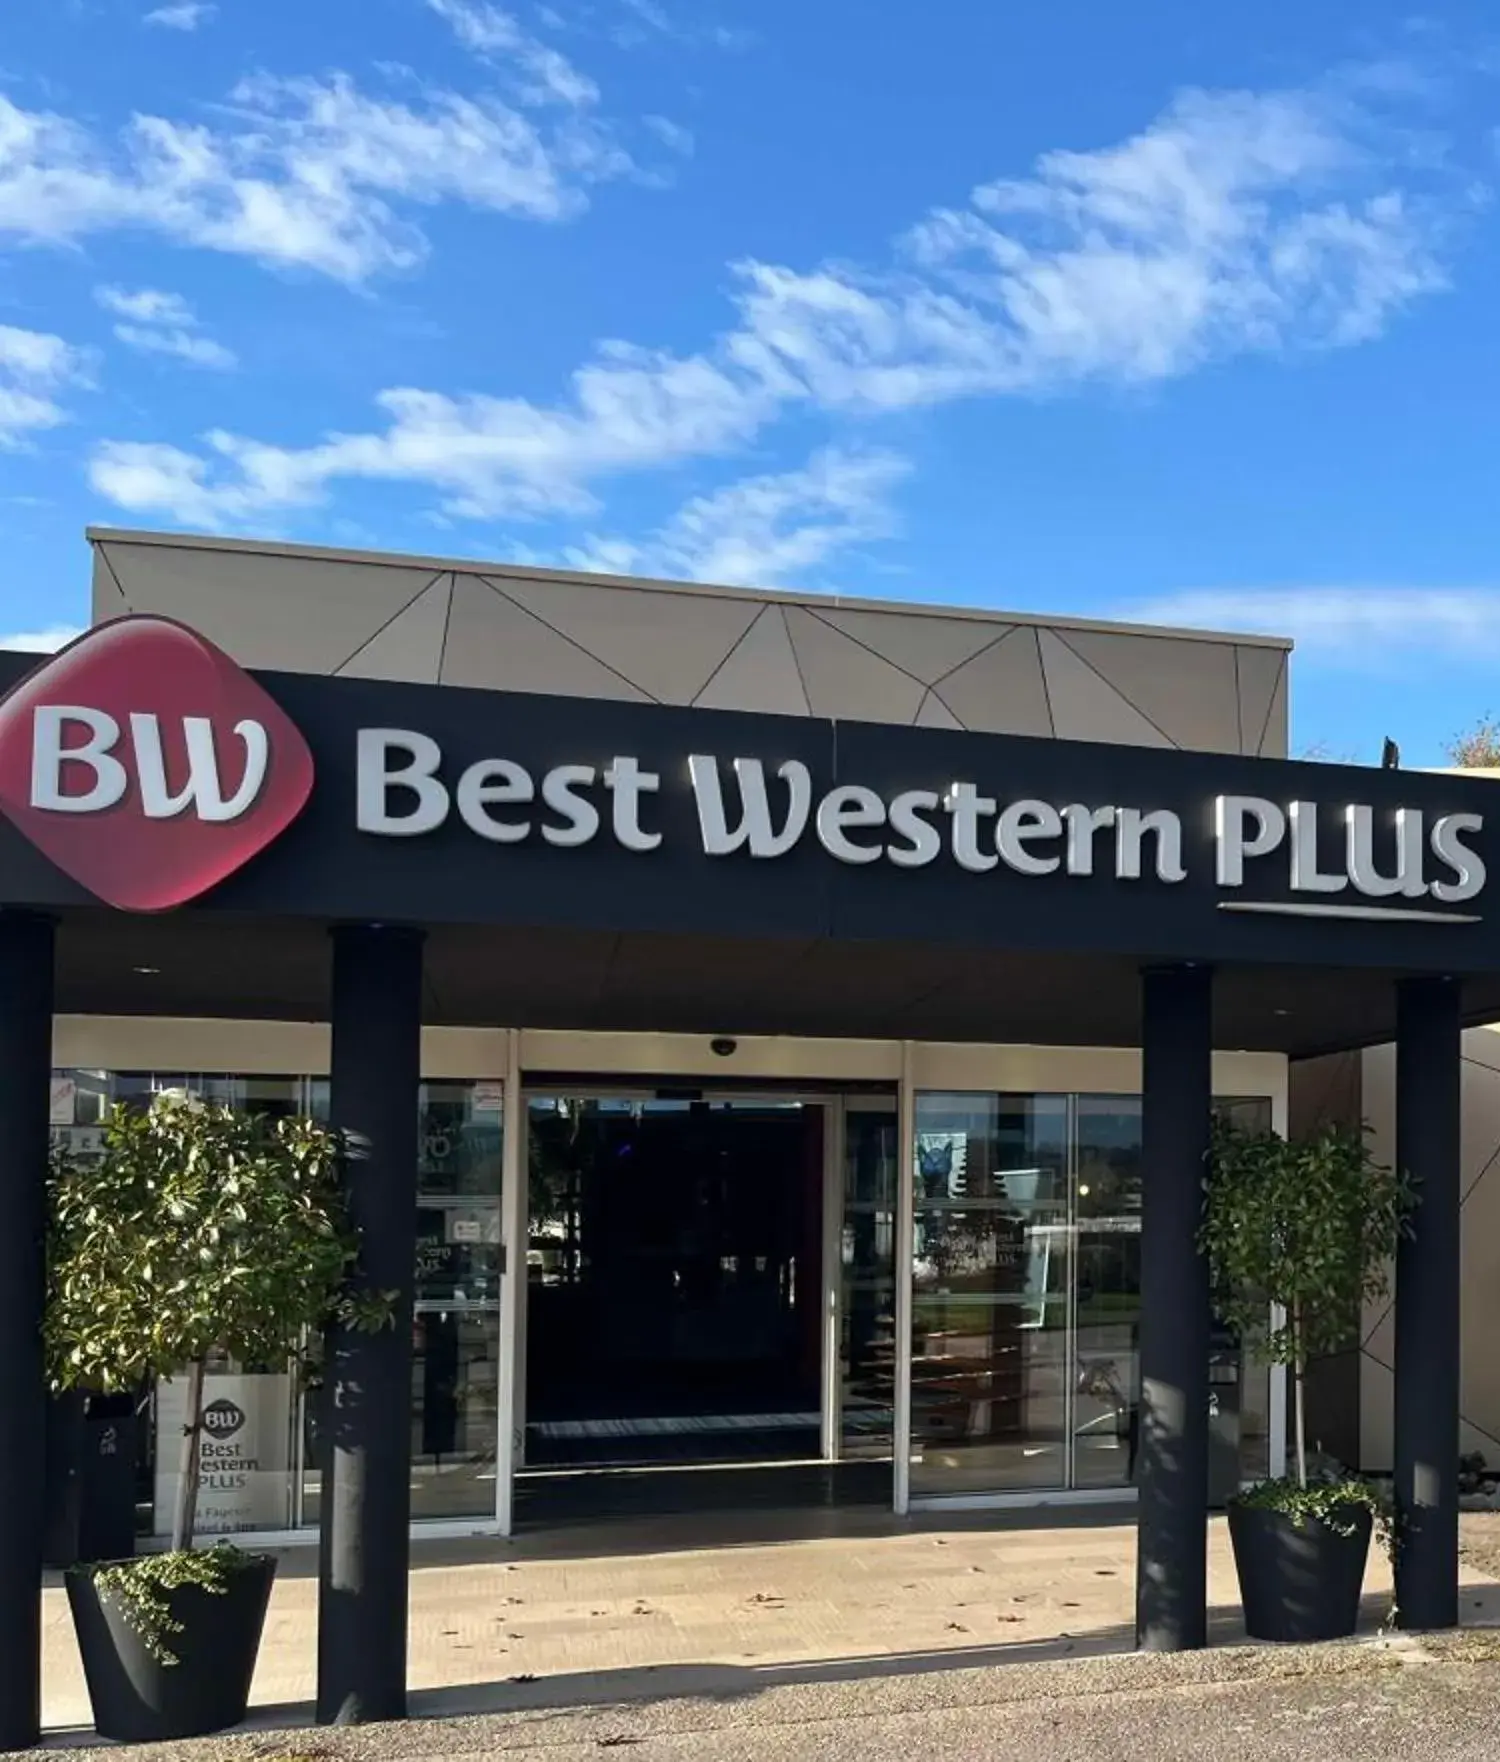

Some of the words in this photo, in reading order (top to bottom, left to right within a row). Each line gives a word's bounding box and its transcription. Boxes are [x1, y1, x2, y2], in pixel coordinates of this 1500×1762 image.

[30, 705, 269, 821] BW
[356, 727, 663, 852] Best
[688, 754, 1187, 884] Western
[1215, 795, 1485, 902] PLUS
[205, 1411, 240, 1428] BW
[201, 1443, 241, 1457] Best
[200, 1459, 259, 1472] estern
